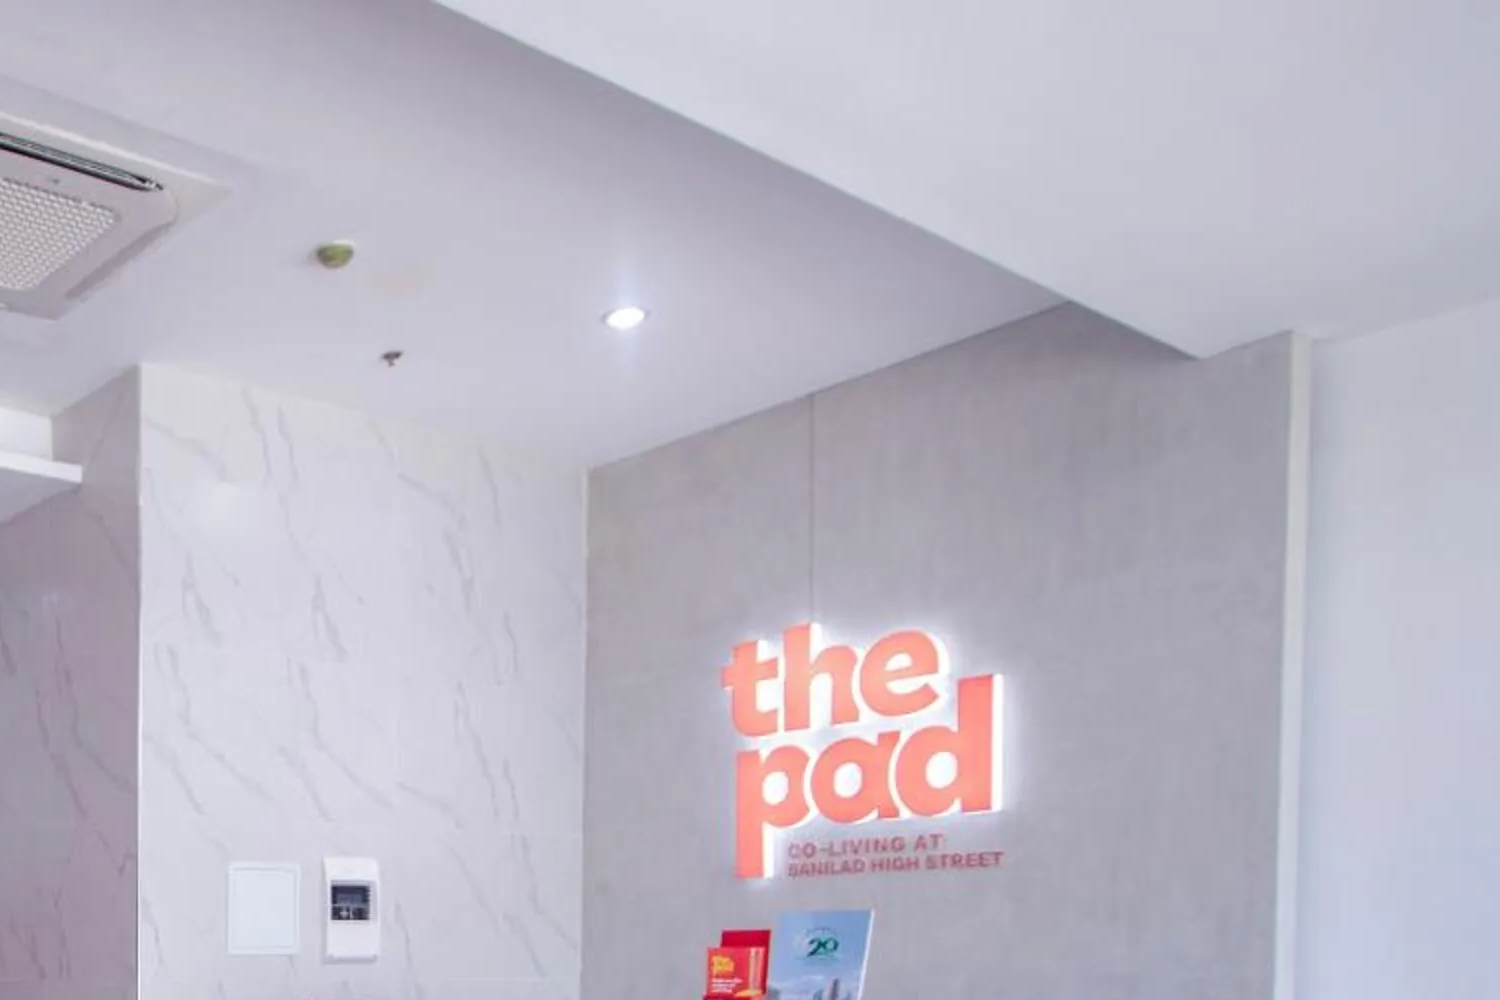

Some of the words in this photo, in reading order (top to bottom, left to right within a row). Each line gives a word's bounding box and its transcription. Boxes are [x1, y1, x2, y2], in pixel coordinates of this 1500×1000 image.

[721, 622, 942, 738] the
[734, 673, 996, 880] pad
[788, 836, 906, 859] CO-LIVING
[914, 833, 944, 851] AT
[788, 859, 866, 878] BANILAD
[871, 856, 920, 873] HIGH
[925, 851, 1004, 870] STREET
